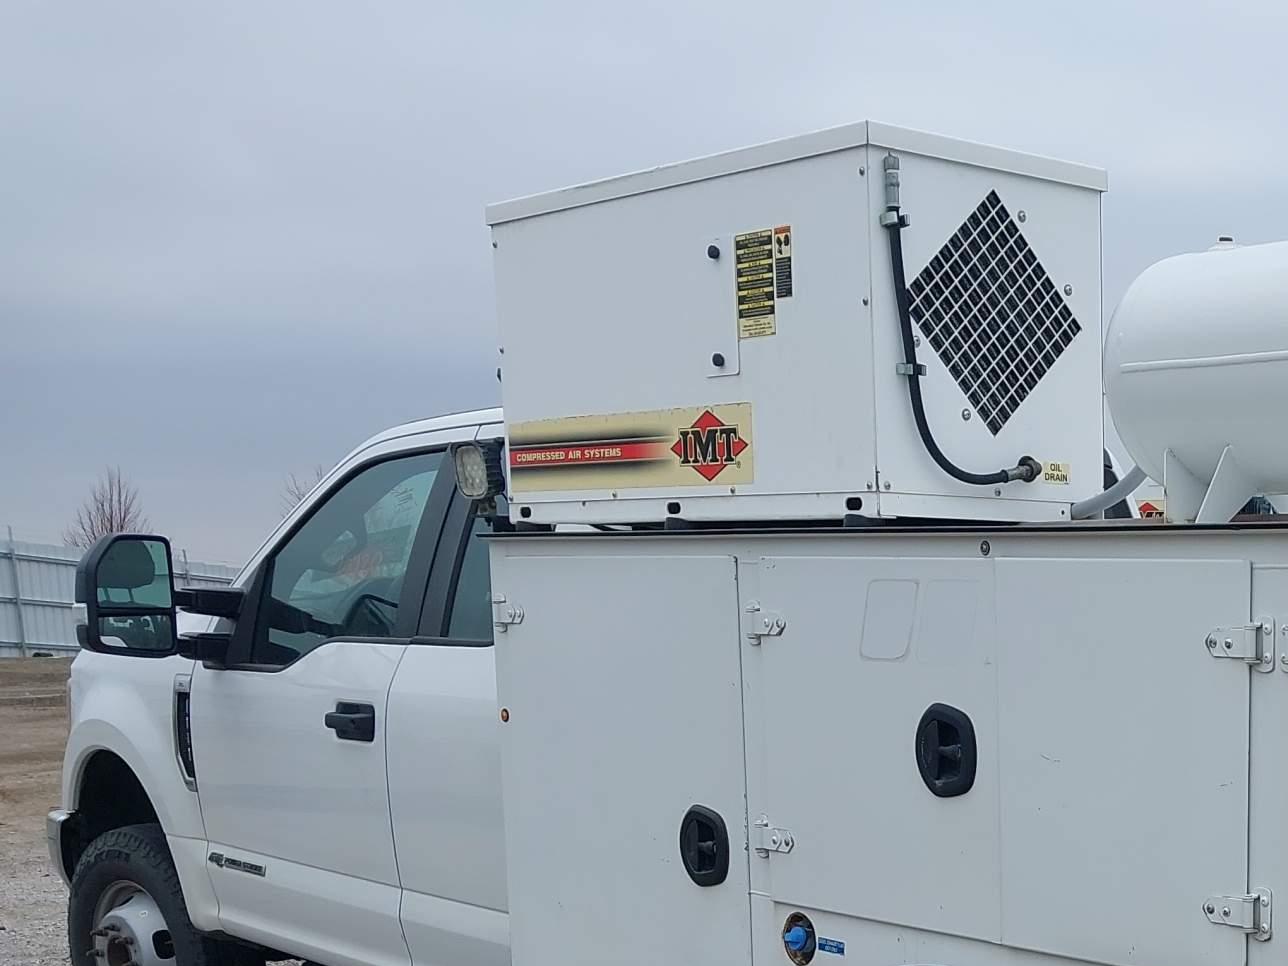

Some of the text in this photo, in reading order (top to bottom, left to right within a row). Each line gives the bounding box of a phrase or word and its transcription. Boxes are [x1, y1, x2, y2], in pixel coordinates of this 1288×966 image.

[679, 426, 738, 466] IMT
[516, 447, 622, 462] COMPRESSED AIR SYSTEMS
[1050, 463, 1062, 472] OIL
[1044, 472, 1067, 481] DRAIN
